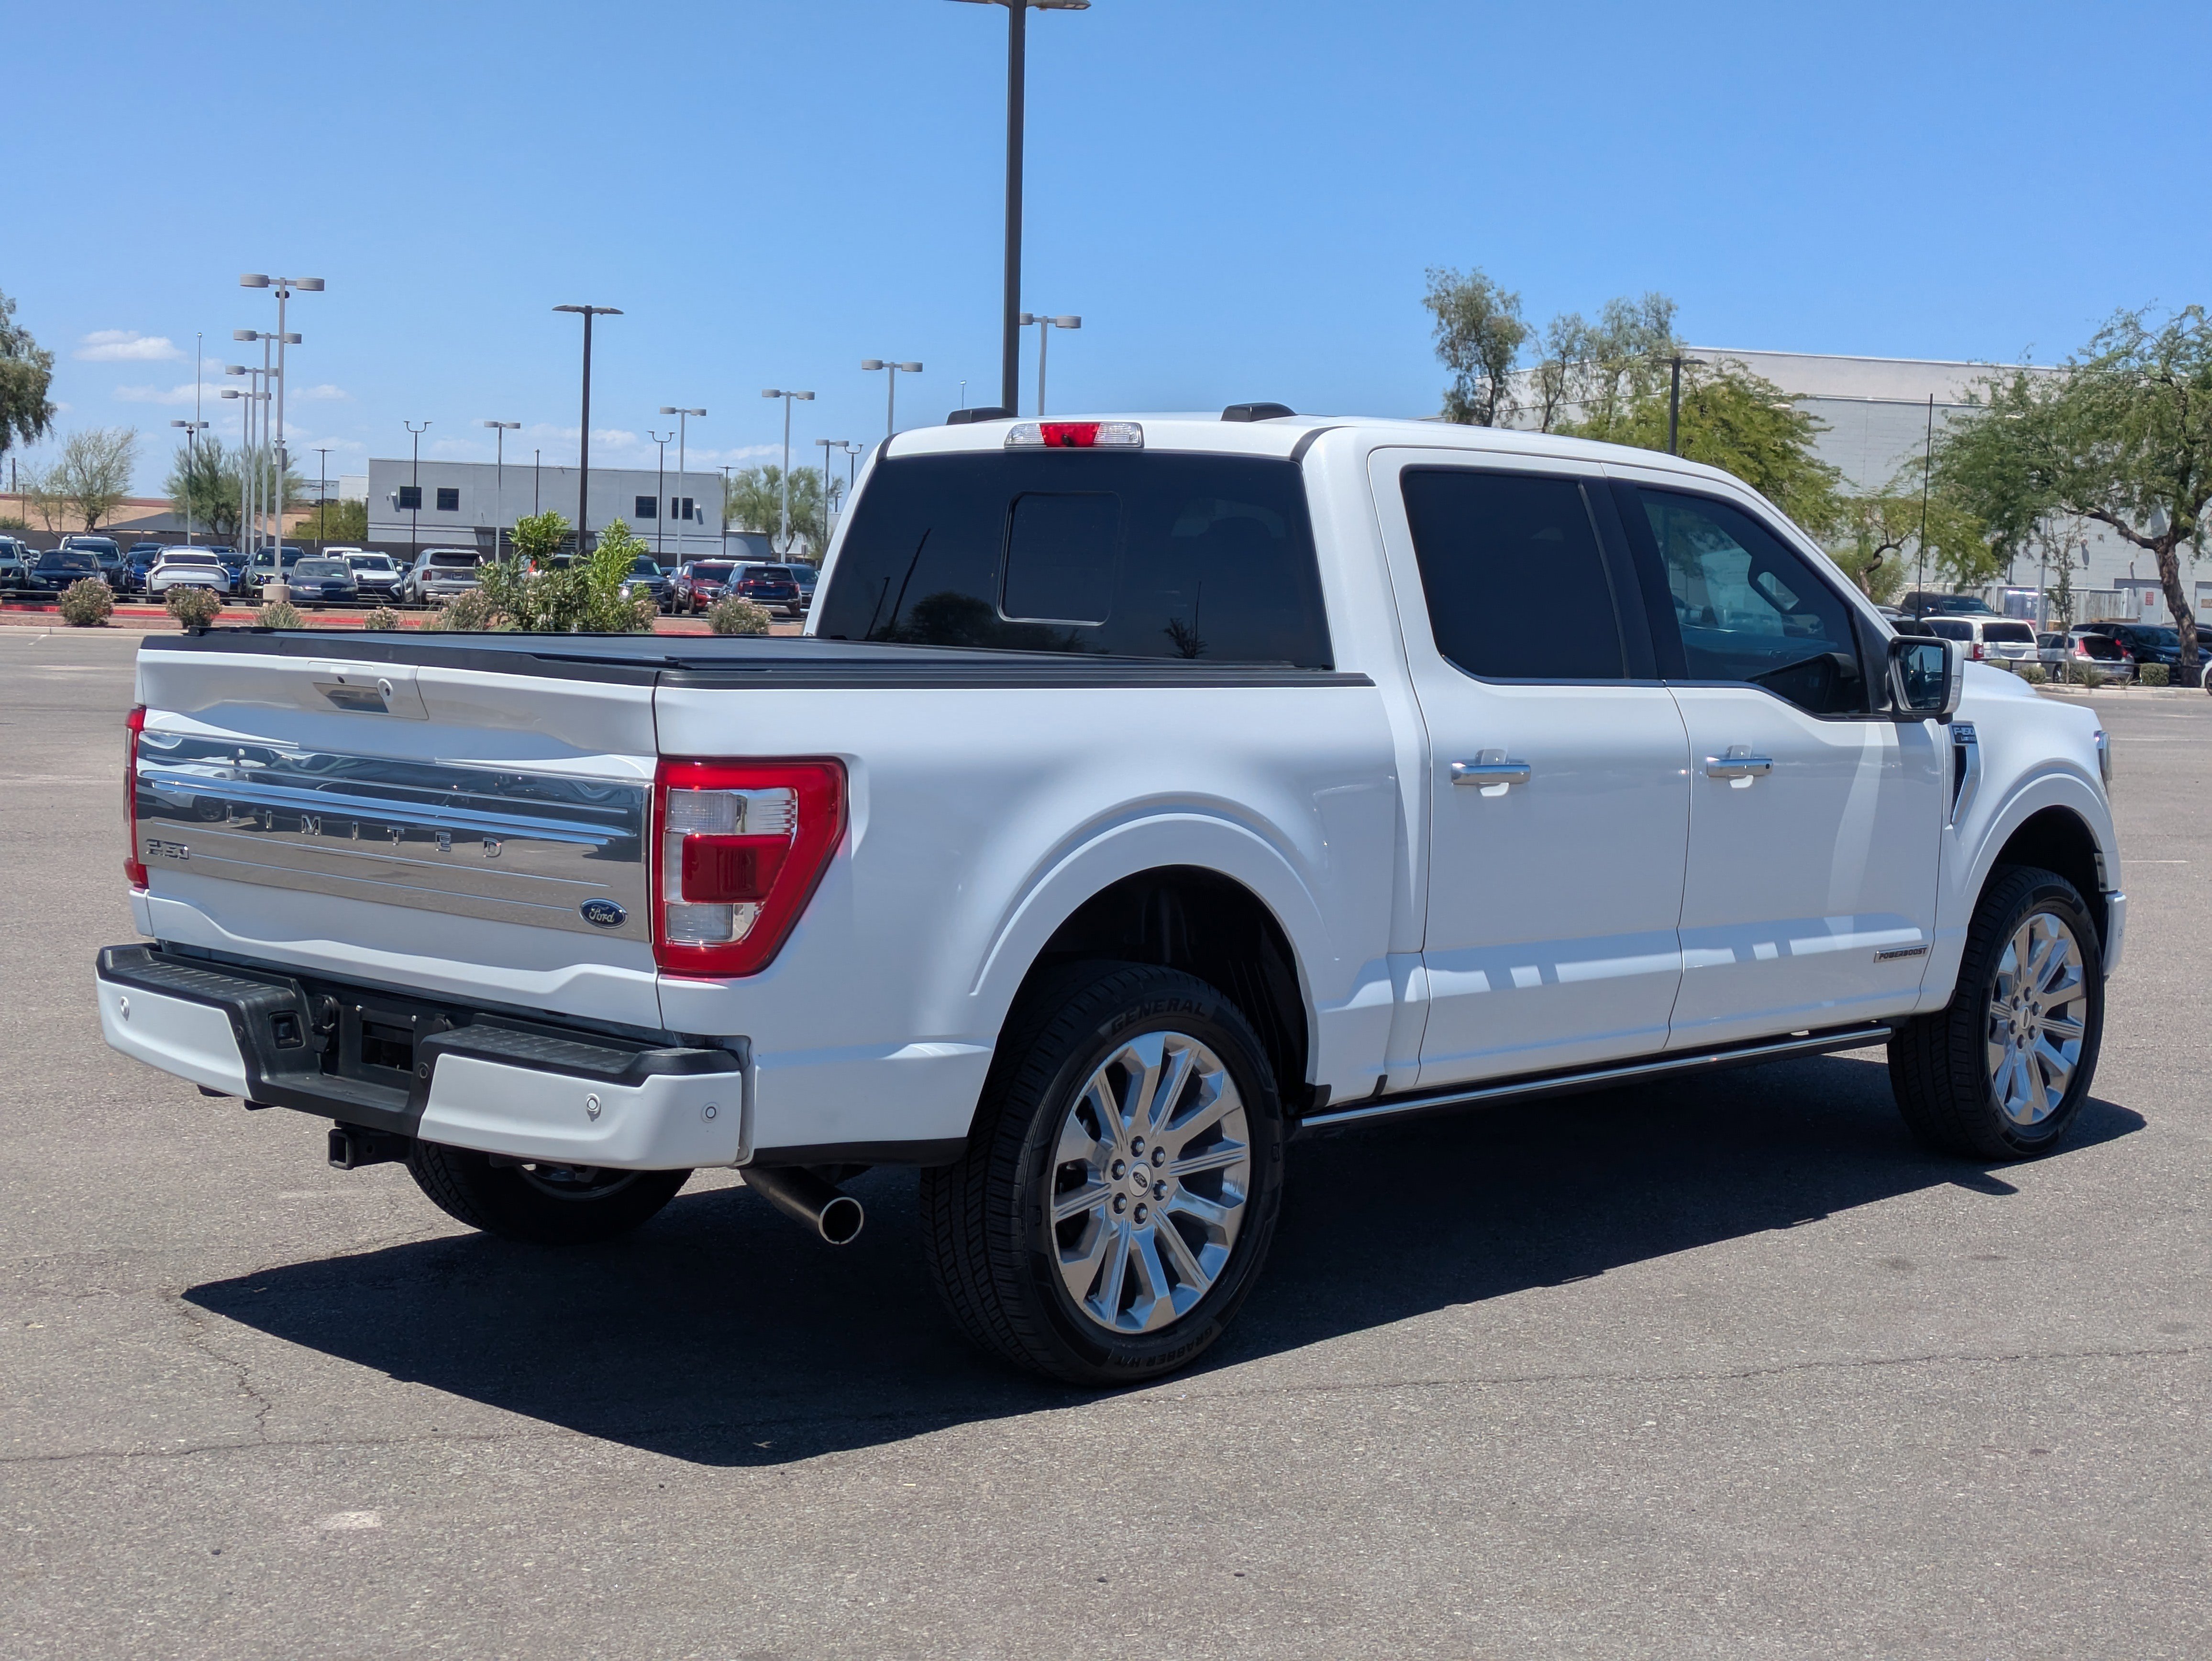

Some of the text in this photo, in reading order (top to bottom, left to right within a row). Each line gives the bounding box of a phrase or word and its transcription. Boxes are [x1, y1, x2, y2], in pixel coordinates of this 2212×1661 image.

[226, 804, 502, 858] LIMITED
[588, 904, 616, 923] Ford
[1879, 947, 1928, 960] POWERBOOST
[1111, 997, 1206, 1036] GENERAL
[1145, 1325, 1213, 1367] GRABBER
